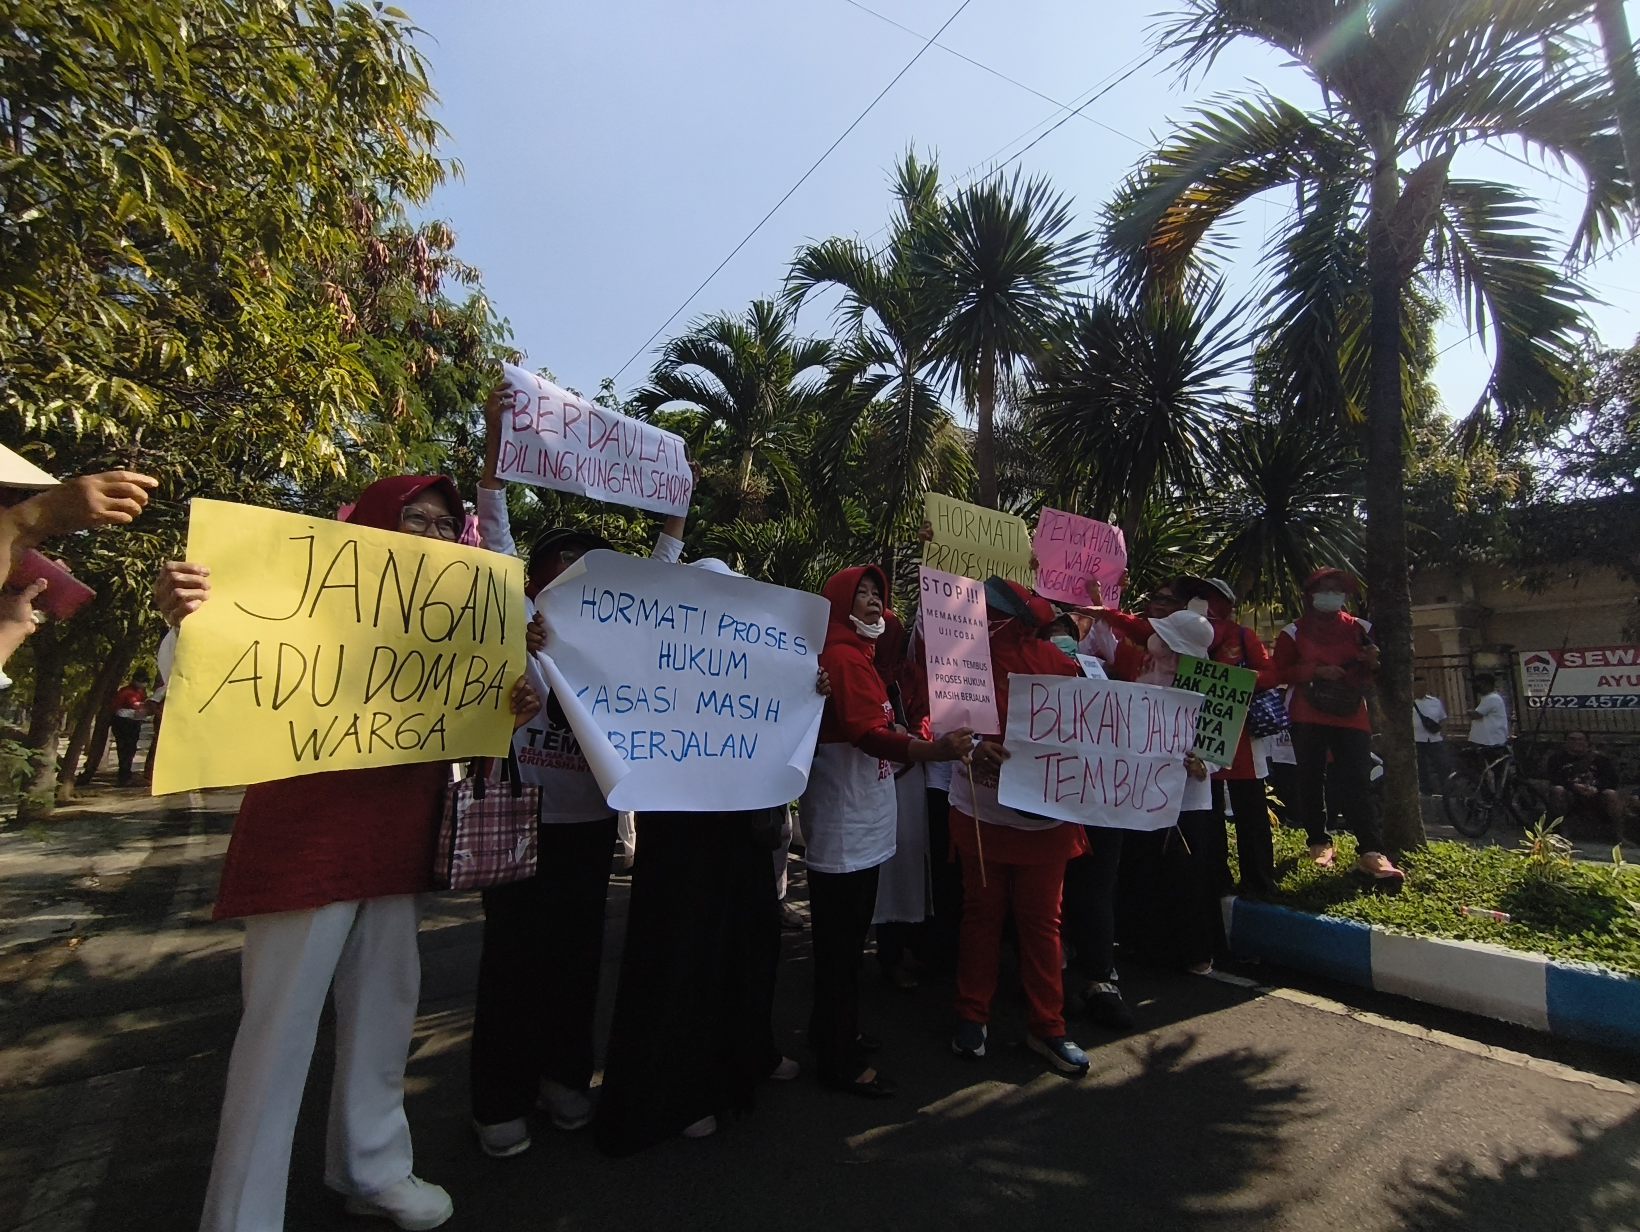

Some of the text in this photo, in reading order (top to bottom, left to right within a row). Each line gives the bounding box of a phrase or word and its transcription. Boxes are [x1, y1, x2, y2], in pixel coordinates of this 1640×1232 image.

[511, 389, 685, 473] BERDAULAT
[937, 501, 1020, 552] HORMATI
[925, 541, 982, 581] PROSES
[233, 525, 508, 645] JANGAN
[921, 575, 963, 601] STOP
[579, 585, 807, 656] HORMATI PROSES
[926, 608, 984, 628] MEMAKSAKAN
[938, 627, 975, 641] UJI COBA
[658, 640, 747, 679] HUKUM
[929, 655, 988, 672] JALAN TEMBUS
[1193, 660, 1230, 683] BELA
[1563, 649, 1640, 667] SEW
[198, 640, 508, 714] ADU DOMBA
[935, 673, 986, 688] PROSES HUKUM
[1171, 672, 1252, 707] HAK ASASI
[576, 685, 781, 723] ASASI MASIH
[934, 690, 991, 704] MASIH BERJALAN
[1584, 696, 1639, 708] 4572
[1029, 682, 1196, 754] BUKAN JALAN
[288, 712, 446, 763] WARGA
[606, 730, 759, 762] BERJALAN
[1034, 752, 1171, 813] TEMBUS
